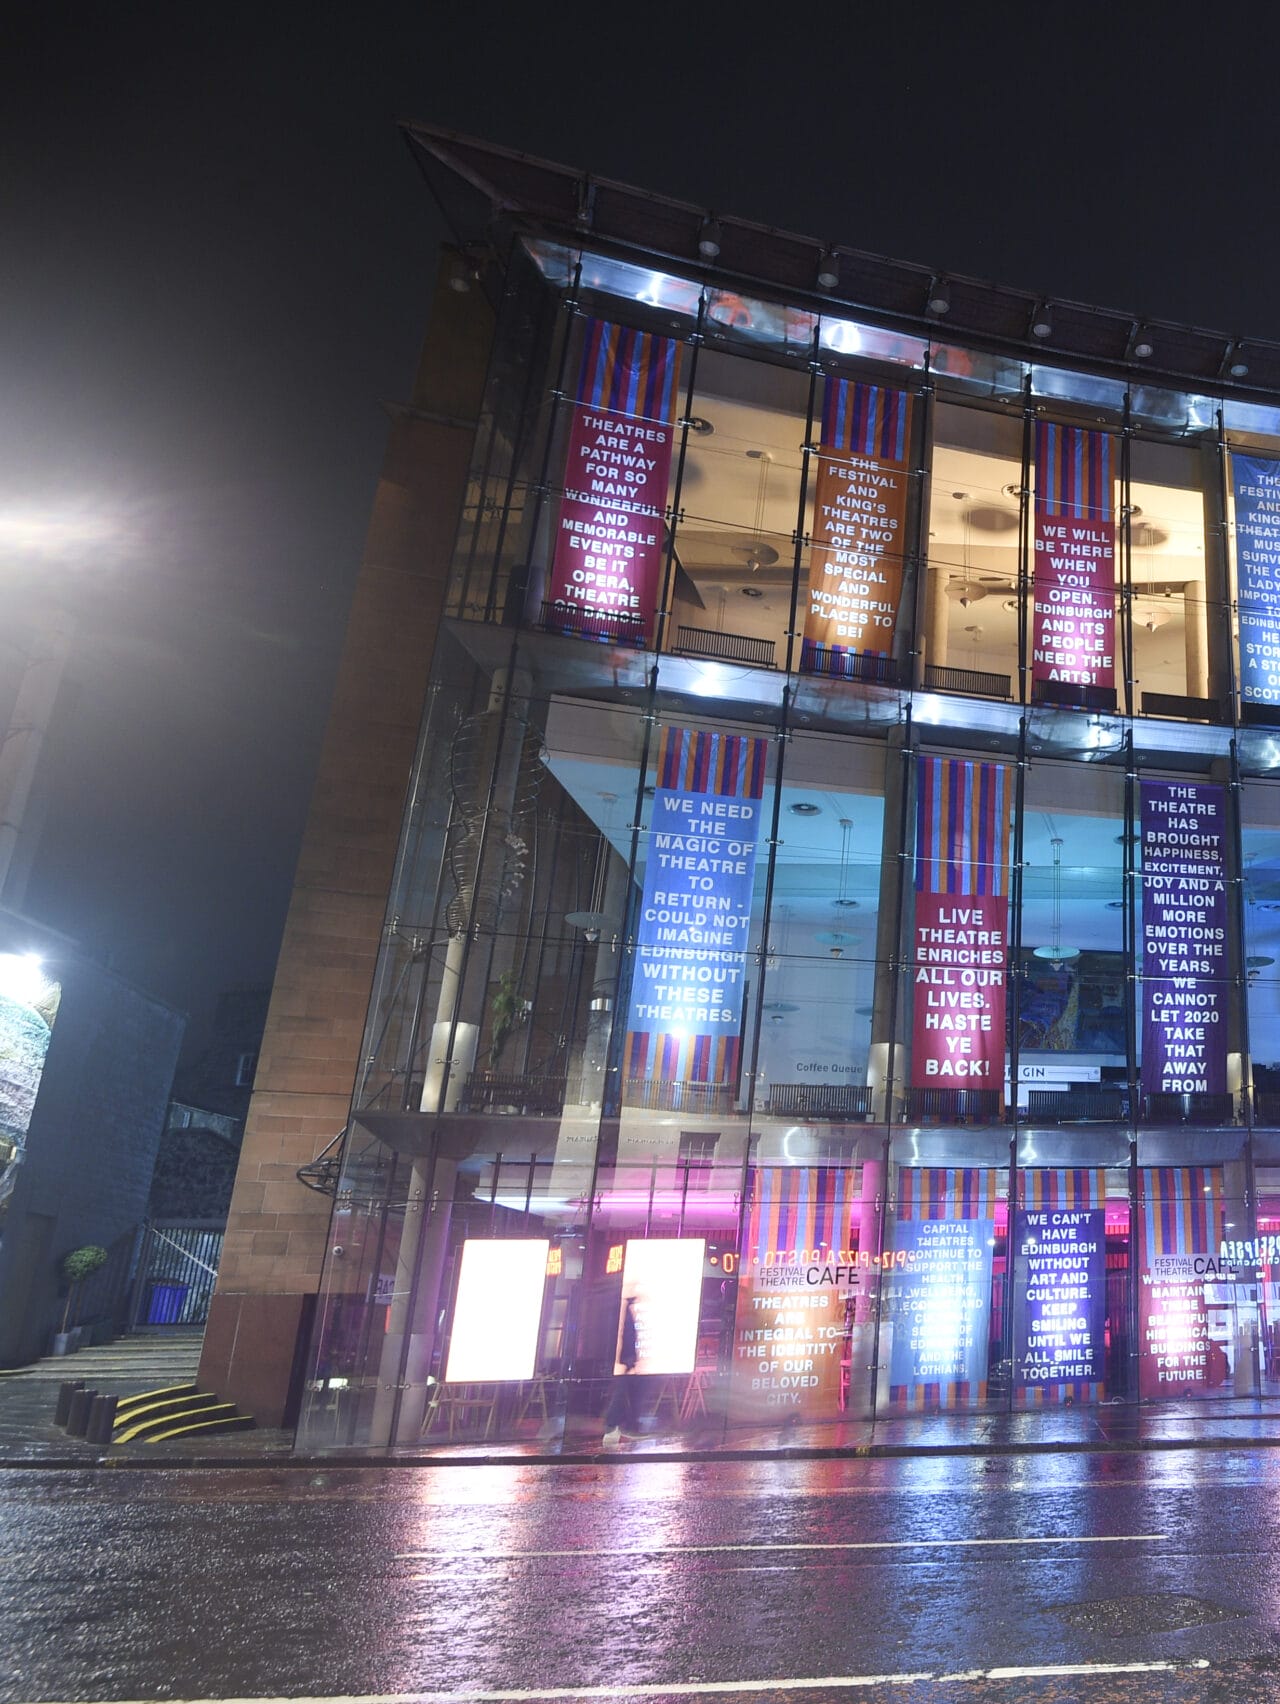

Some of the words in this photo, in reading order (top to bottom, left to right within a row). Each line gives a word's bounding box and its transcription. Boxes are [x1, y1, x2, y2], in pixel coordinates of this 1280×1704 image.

[583, 415, 666, 443] THEATRES
[595, 434, 628, 450] ARE
[581, 447, 656, 471] PATHWAY
[586, 463, 618, 479] FOR
[829, 466, 897, 489] FESTIVAL
[592, 480, 638, 498] MANY
[837, 495, 886, 513] KING'S
[594, 511, 628, 527] AND
[822, 506, 898, 529] THEATRES
[563, 518, 656, 546] MEMORABLE
[861, 527, 893, 542] TWO
[1072, 529, 1110, 542] WILL
[570, 536, 634, 557] EVENTS
[1061, 542, 1112, 558] THERE
[836, 551, 877, 568] MOST
[1050, 558, 1096, 572] WHEN
[825, 563, 886, 583] SPECIAL
[573, 570, 634, 592] OPERA,
[565, 585, 640, 607] THEATRE
[811, 589, 895, 613] WONDERFUL
[1049, 590, 1097, 605] OPEN.
[811, 604, 868, 624] PLACES
[1035, 602, 1112, 618] EDINBURGH
[1042, 635, 1104, 651] PEOPLE
[1034, 650, 1076, 665] NEED
[1049, 669, 1096, 684] ARTS!
[1149, 801, 1216, 815] THEATRE
[656, 834, 721, 854] MAGIC
[1147, 832, 1219, 846] BROUGHT
[1145, 847, 1223, 862] HAPPINESS,
[659, 854, 747, 875] THEATRE
[1145, 862, 1223, 876] EXCITEMENT,
[1179, 880, 1209, 890] AND
[654, 892, 730, 910] RETURN
[1154, 893, 1215, 907] MILLION
[645, 909, 707, 925] COULD
[939, 908, 983, 925] LIVE
[1163, 910, 1206, 922] MORE
[657, 928, 733, 945] IMAGINE
[919, 928, 1002, 945] THEATRE
[1146, 925, 1224, 939] EMOTIONS
[917, 947, 1003, 964] ENRICHES
[1148, 942, 1187, 954] OVER
[643, 963, 740, 983] WITHOUT
[1159, 959, 1214, 974] YEARS,
[916, 968, 954, 985] ALL
[961, 970, 1003, 986] OUR
[654, 985, 723, 1003] THESE
[928, 991, 990, 1008] LIVES.
[1153, 993, 1217, 1006] CANNOT
[636, 1004, 736, 1022] THEATRES.
[926, 1013, 991, 1031] HASTE
[1165, 1027, 1205, 1040] TAKE
[1165, 1045, 1205, 1057] THAT
[797, 1063, 828, 1072] Coffee
[832, 1064, 863, 1073] Queue
[926, 1059, 990, 1076] BACK!
[1023, 1067, 1044, 1077] GIN
[1163, 1062, 1206, 1074] AWAY
[1162, 1080, 1207, 1092] FROM
[1052, 1214, 1092, 1224] CAN'T
[917, 1236, 974, 1247] THEATRES
[1021, 1243, 1096, 1255] EDINBURGH
[908, 1249, 965, 1260] CONTINUE
[907, 1262, 959, 1272] SUPPORT
[1029, 1258, 1089, 1269] WITHOUT
[1155, 1259, 1192, 1267] FESTIVAL
[760, 1267, 805, 1277] FESTIVAL
[760, 1277, 804, 1287] THEATRE
[1026, 1288, 1091, 1300] CULTURE.
[1032, 1318, 1087, 1332] SMILING
[1028, 1335, 1065, 1347] UNTIL
[738, 1347, 766, 1357] THE
[1054, 1350, 1093, 1361] SMILE
[784, 1360, 813, 1371] OUR
[1157, 1357, 1179, 1367] FOR
[1183, 1355, 1206, 1366] THE
[1021, 1365, 1095, 1379] TOGETHER.
[1159, 1370, 1206, 1382] FUTURE.
[752, 1376, 819, 1389] BELOVED
